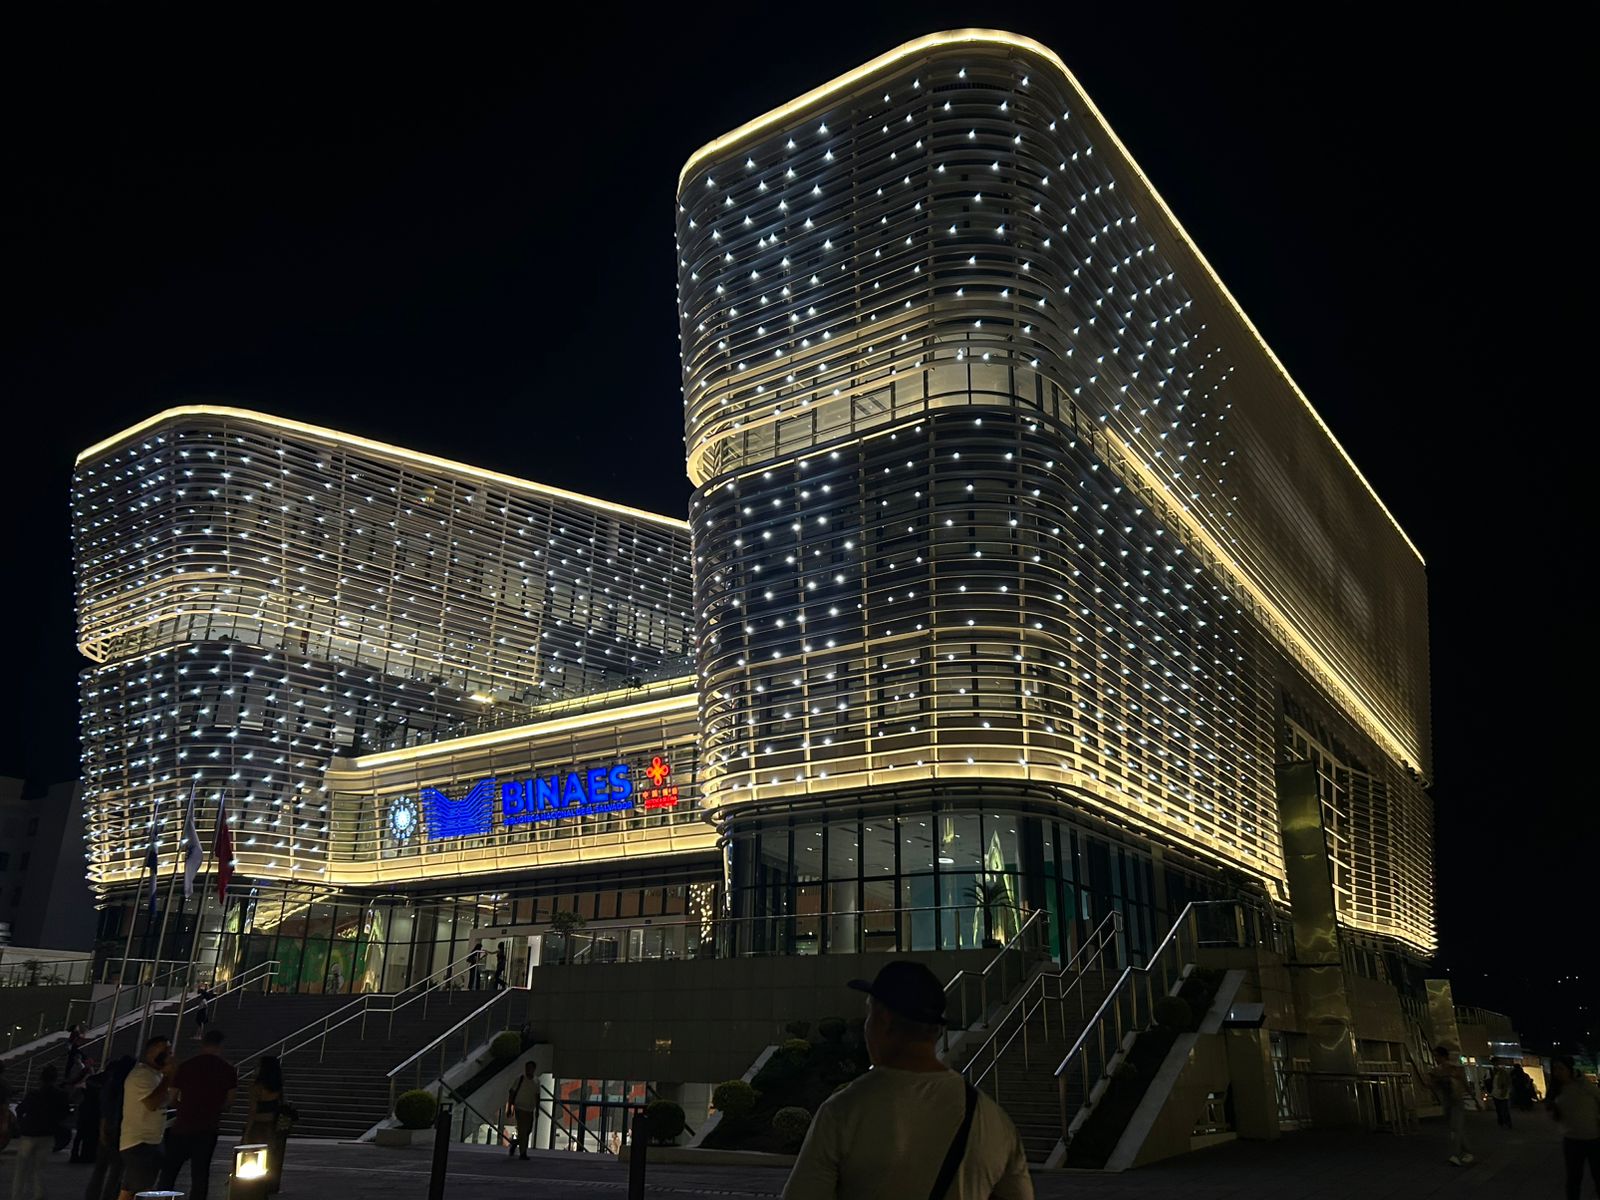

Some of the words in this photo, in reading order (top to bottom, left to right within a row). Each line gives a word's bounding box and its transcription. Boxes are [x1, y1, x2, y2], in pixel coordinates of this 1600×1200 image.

[502, 765, 632, 814] BINAES
[541, 809, 576, 820] NACIONAL
[595, 801, 633, 813] SALVADOR
